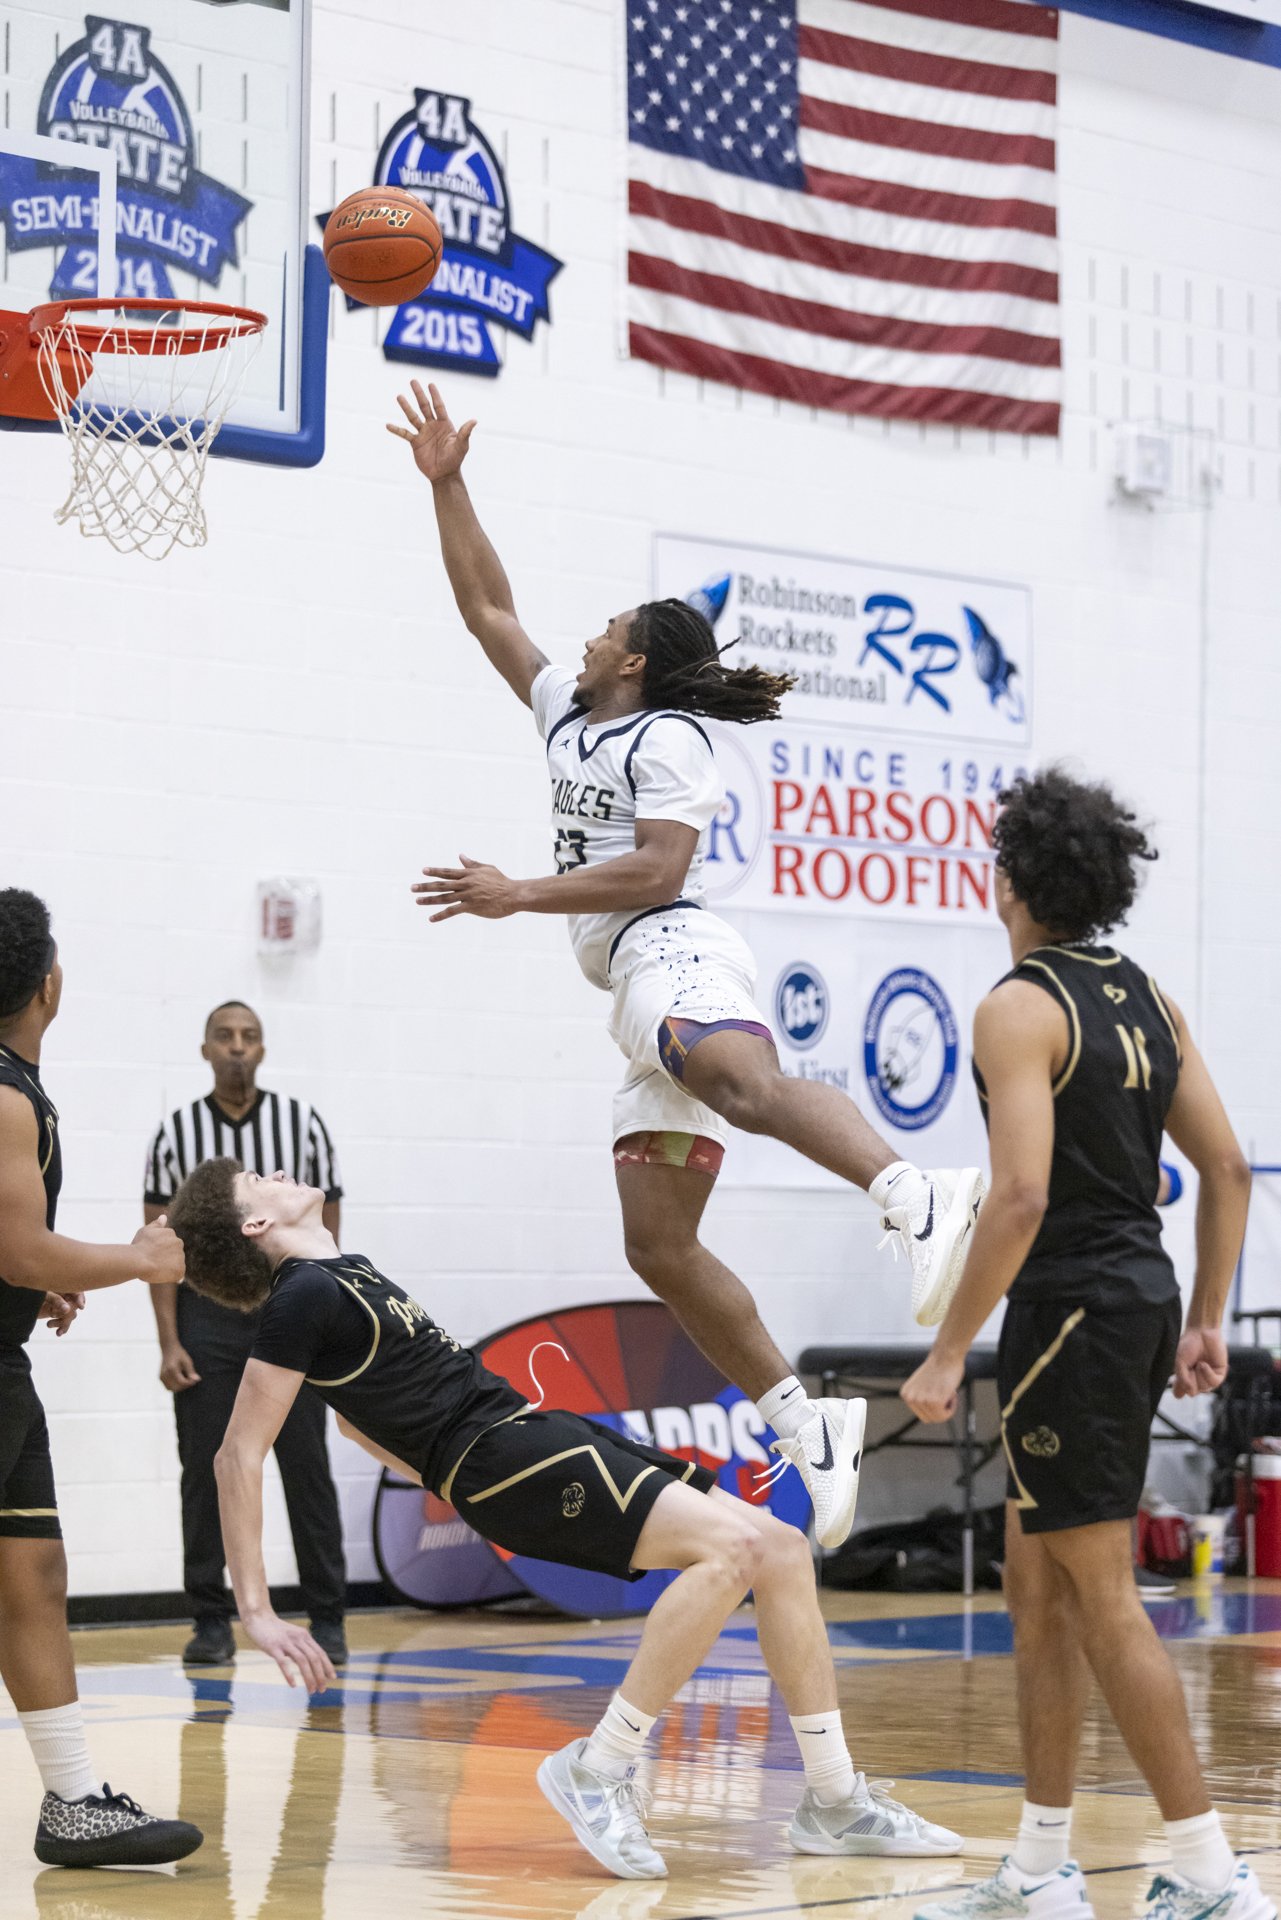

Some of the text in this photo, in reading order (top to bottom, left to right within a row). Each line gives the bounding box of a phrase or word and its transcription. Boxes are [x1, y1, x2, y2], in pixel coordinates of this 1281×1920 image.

[90, 24, 148, 79] 4A
[417, 95, 469, 145] 4A
[11, 194, 218, 267] SEMI-NALIST
[71, 249, 158, 298] 214
[401, 306, 482, 357] 2015
[738, 575, 856, 620] Robinson
[739, 616, 837, 658] Rockets
[770, 741, 906, 787] SINCE
[772, 780, 1000, 850] PARSON
[772, 844, 990, 911] ROOFIN
[1115, 1024, 1151, 1090] 11
